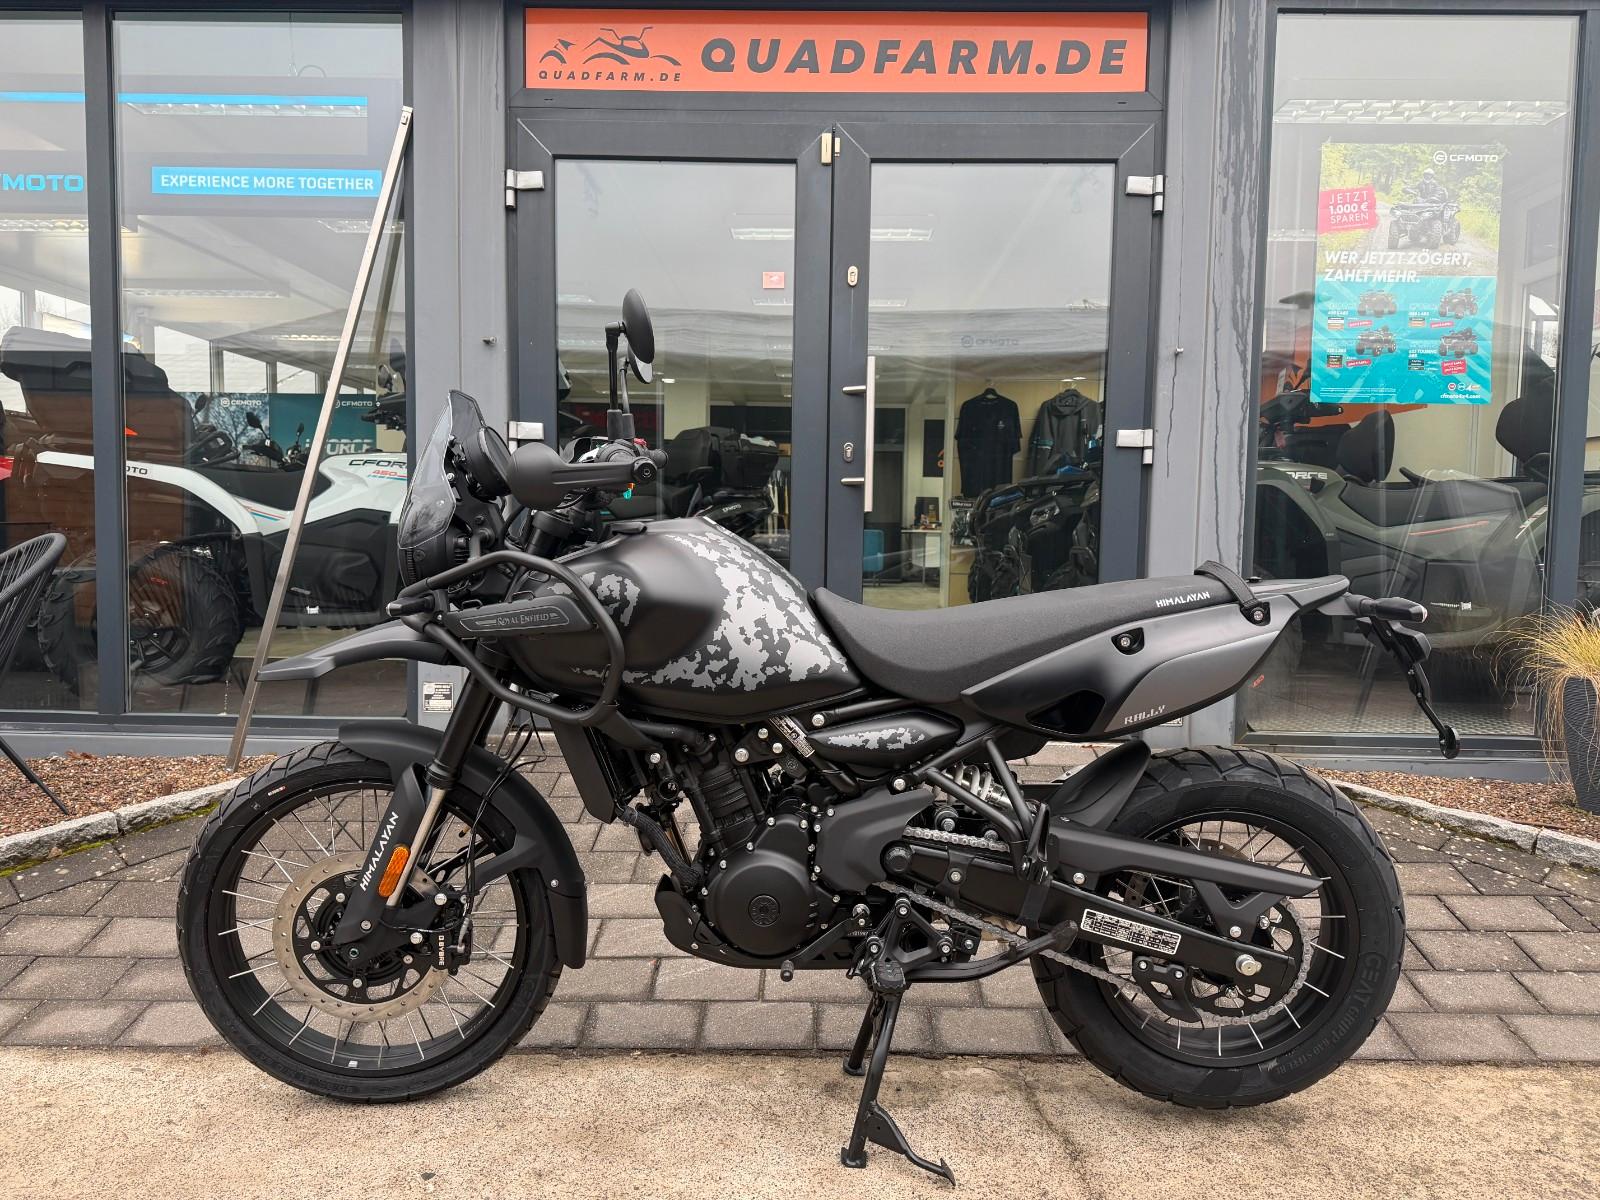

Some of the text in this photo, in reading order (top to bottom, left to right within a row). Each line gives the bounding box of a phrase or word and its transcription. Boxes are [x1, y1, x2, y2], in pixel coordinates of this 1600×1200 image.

[700, 38, 1128, 75] QUADFARM.DE
[538, 70, 681, 82] QUADFARM.DE
[1449, 154, 1499, 162] CFMOTO
[0, 173, 85, 192] MOTO
[160, 174, 374, 190] EXPERIENCE MORE TOGETHER
[1329, 190, 1369, 204] JETZT
[1328, 203, 1358, 215] 1.000
[1330, 213, 1369, 225] SPAREN
[1325, 248, 1472, 268] WER JETZT ZÖGERT,
[1323, 269, 1421, 283] ZAHLT MEHR.
[348, 459, 408, 468] CFOR
[1155, 591, 1211, 608] HIMALAYAN
[497, 613, 550, 626] ROYAL ENFIELD
[1124, 704, 1166, 725] RALLY
[359, 811, 399, 892] HIMALAYAN
